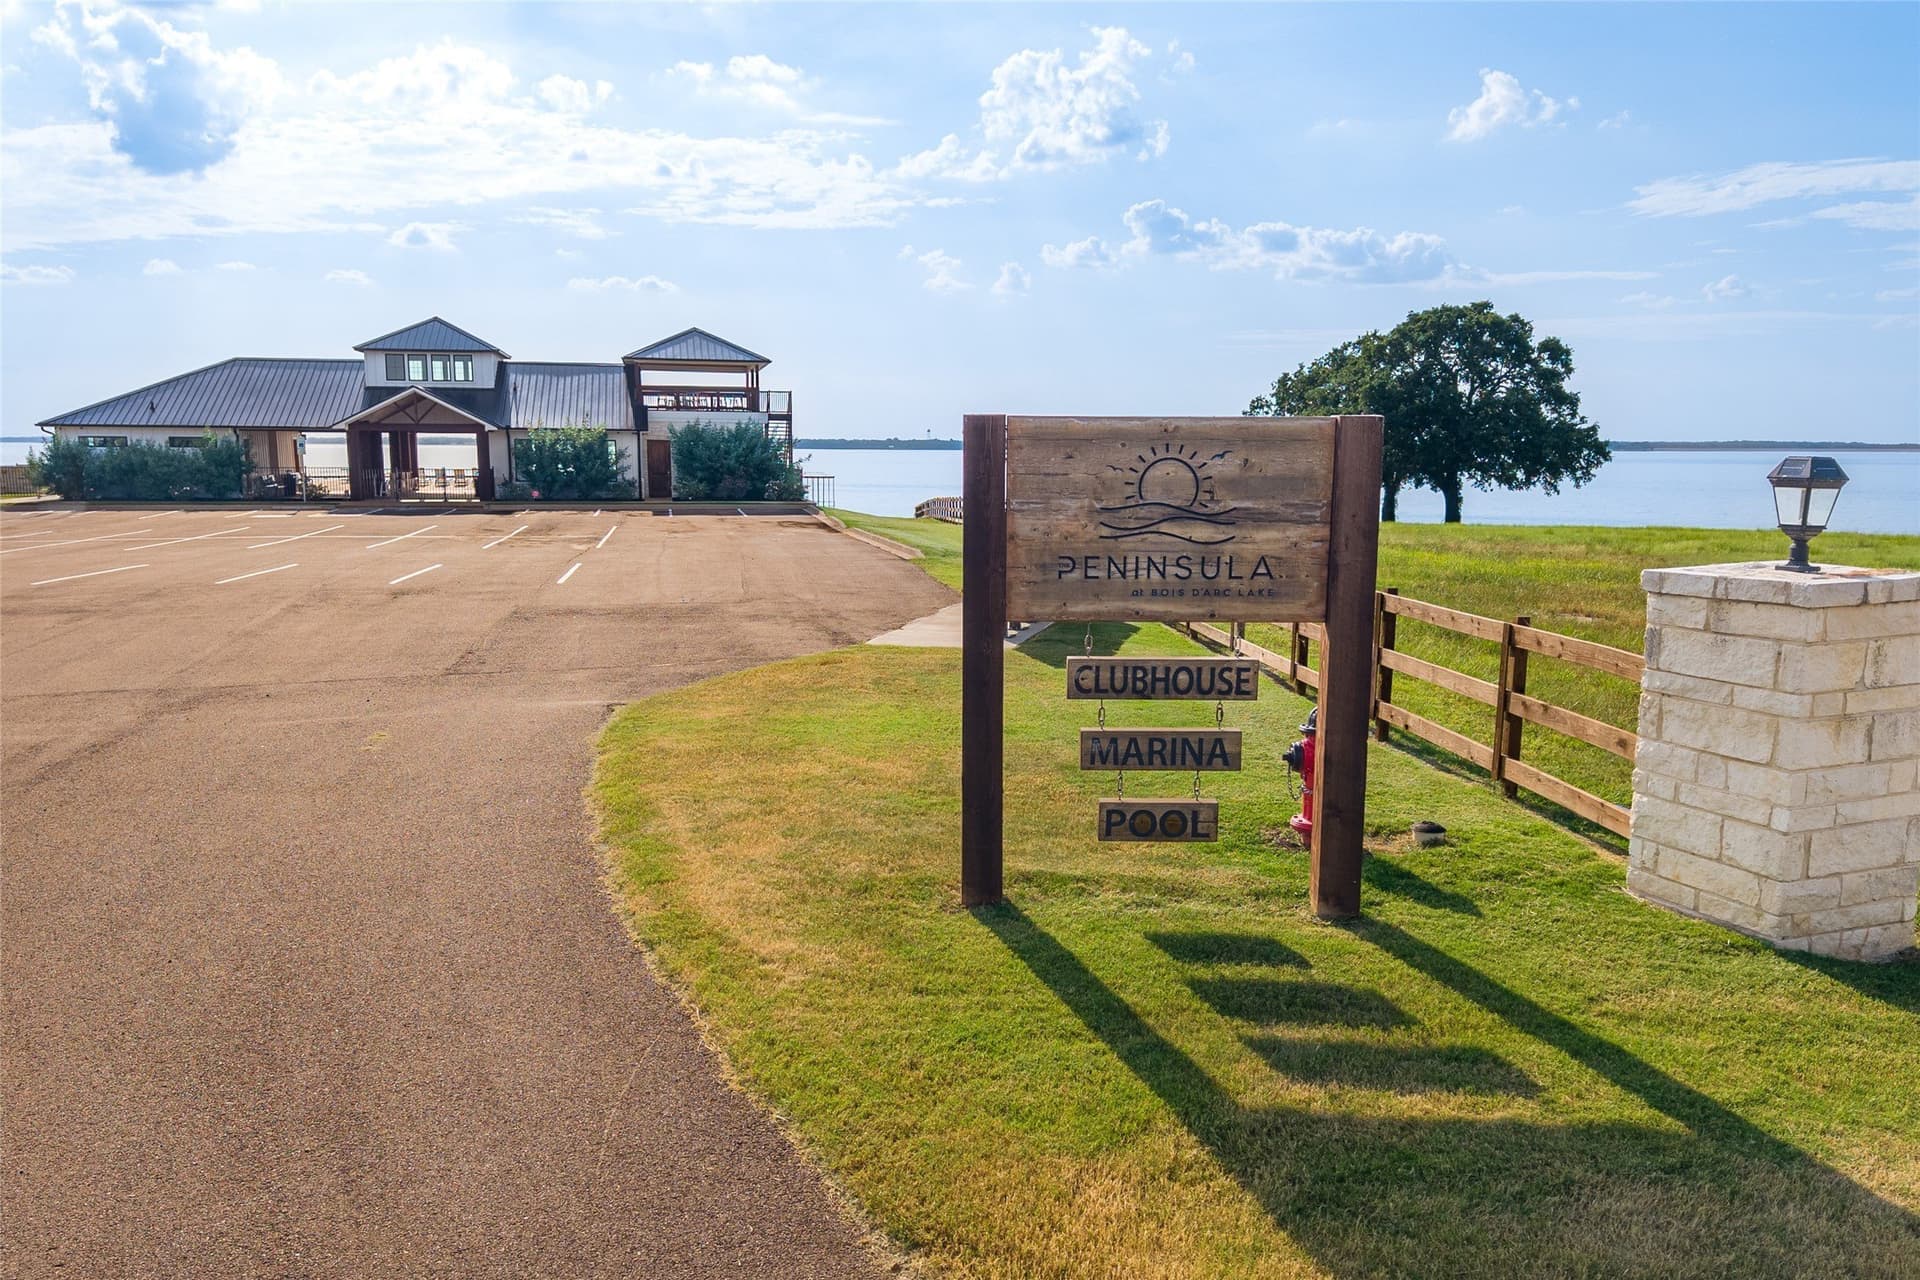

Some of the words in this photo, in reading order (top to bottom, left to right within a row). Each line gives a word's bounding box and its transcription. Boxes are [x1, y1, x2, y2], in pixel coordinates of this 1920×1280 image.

[1058, 555, 1274, 580] PENINSULA
[1131, 588, 1144, 598] at
[1151, 588, 1185, 598] BOIS
[1191, 588, 1231, 598] D'ARC
[1237, 588, 1275, 598] LAKE
[1074, 665, 1251, 696] CLUBHOUSE
[1089, 737, 1230, 767] MARINA
[1104, 809, 1210, 839] POOL
